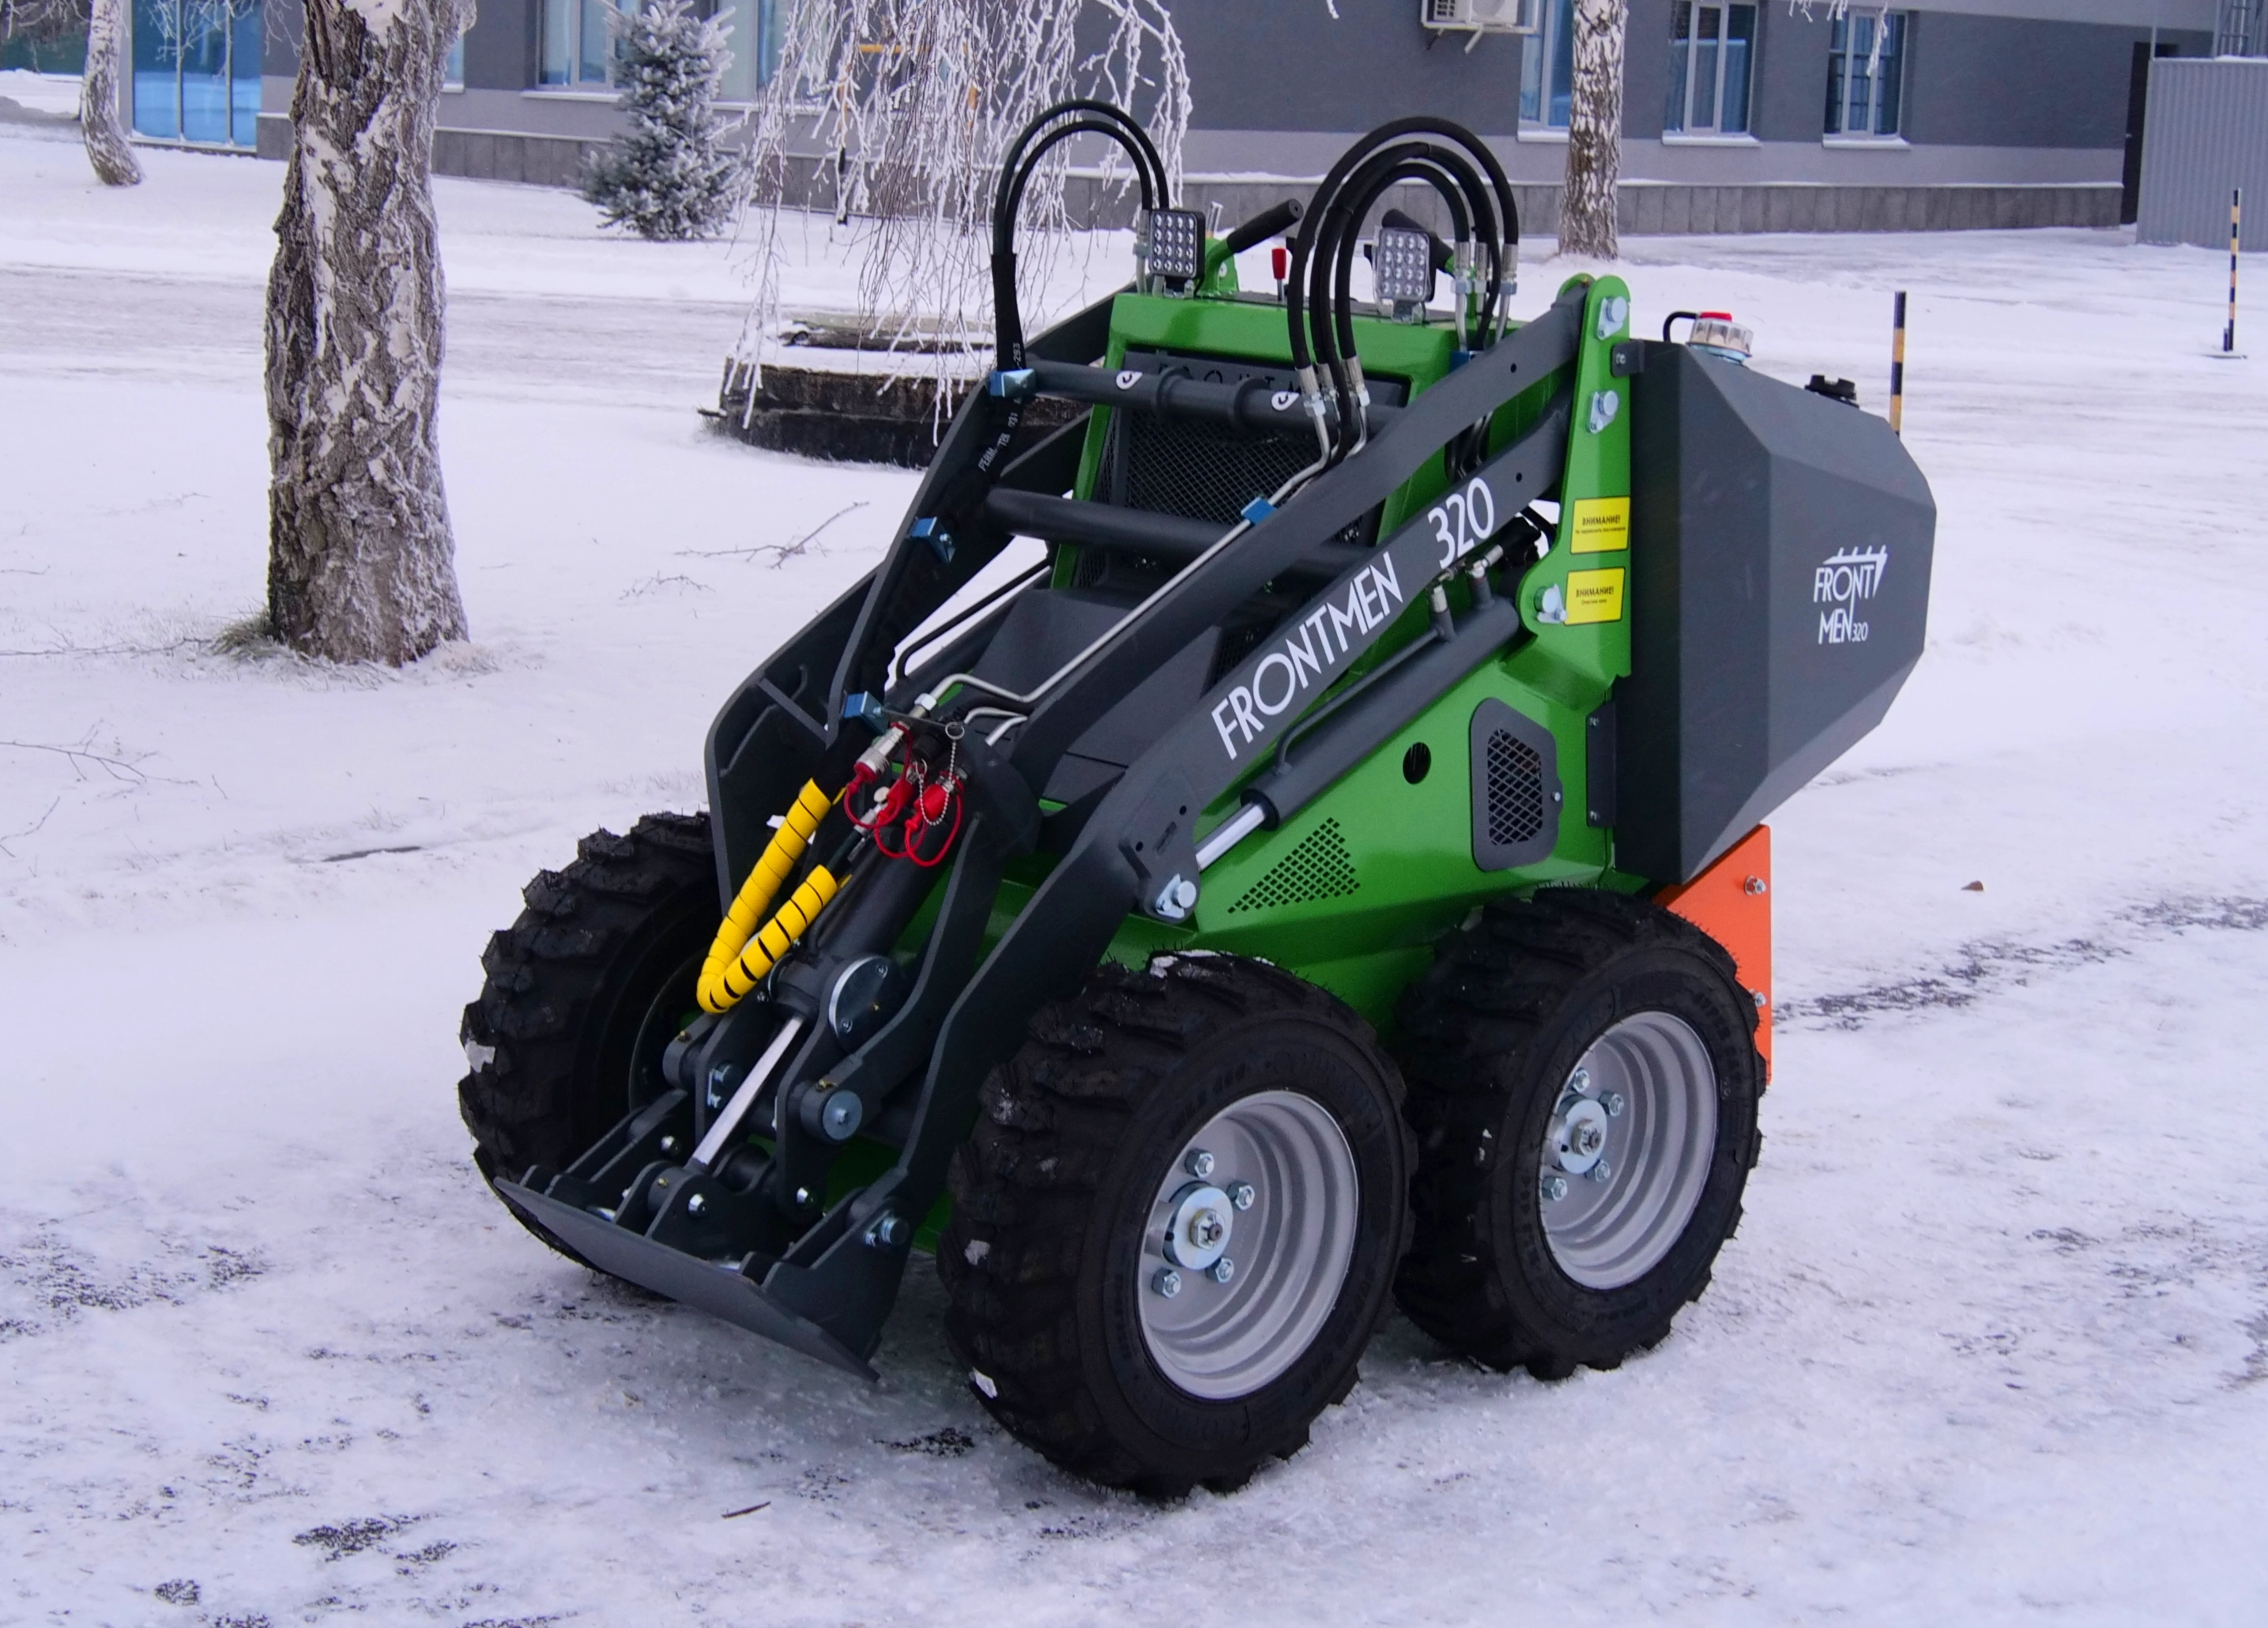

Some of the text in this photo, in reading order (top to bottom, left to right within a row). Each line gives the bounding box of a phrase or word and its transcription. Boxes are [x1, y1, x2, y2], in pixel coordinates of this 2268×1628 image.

[1814, 564, 1875, 603] FRONT
[1211, 477, 1494, 760] FRONTMEN 320
[1818, 608, 1869, 645] MEN 320
